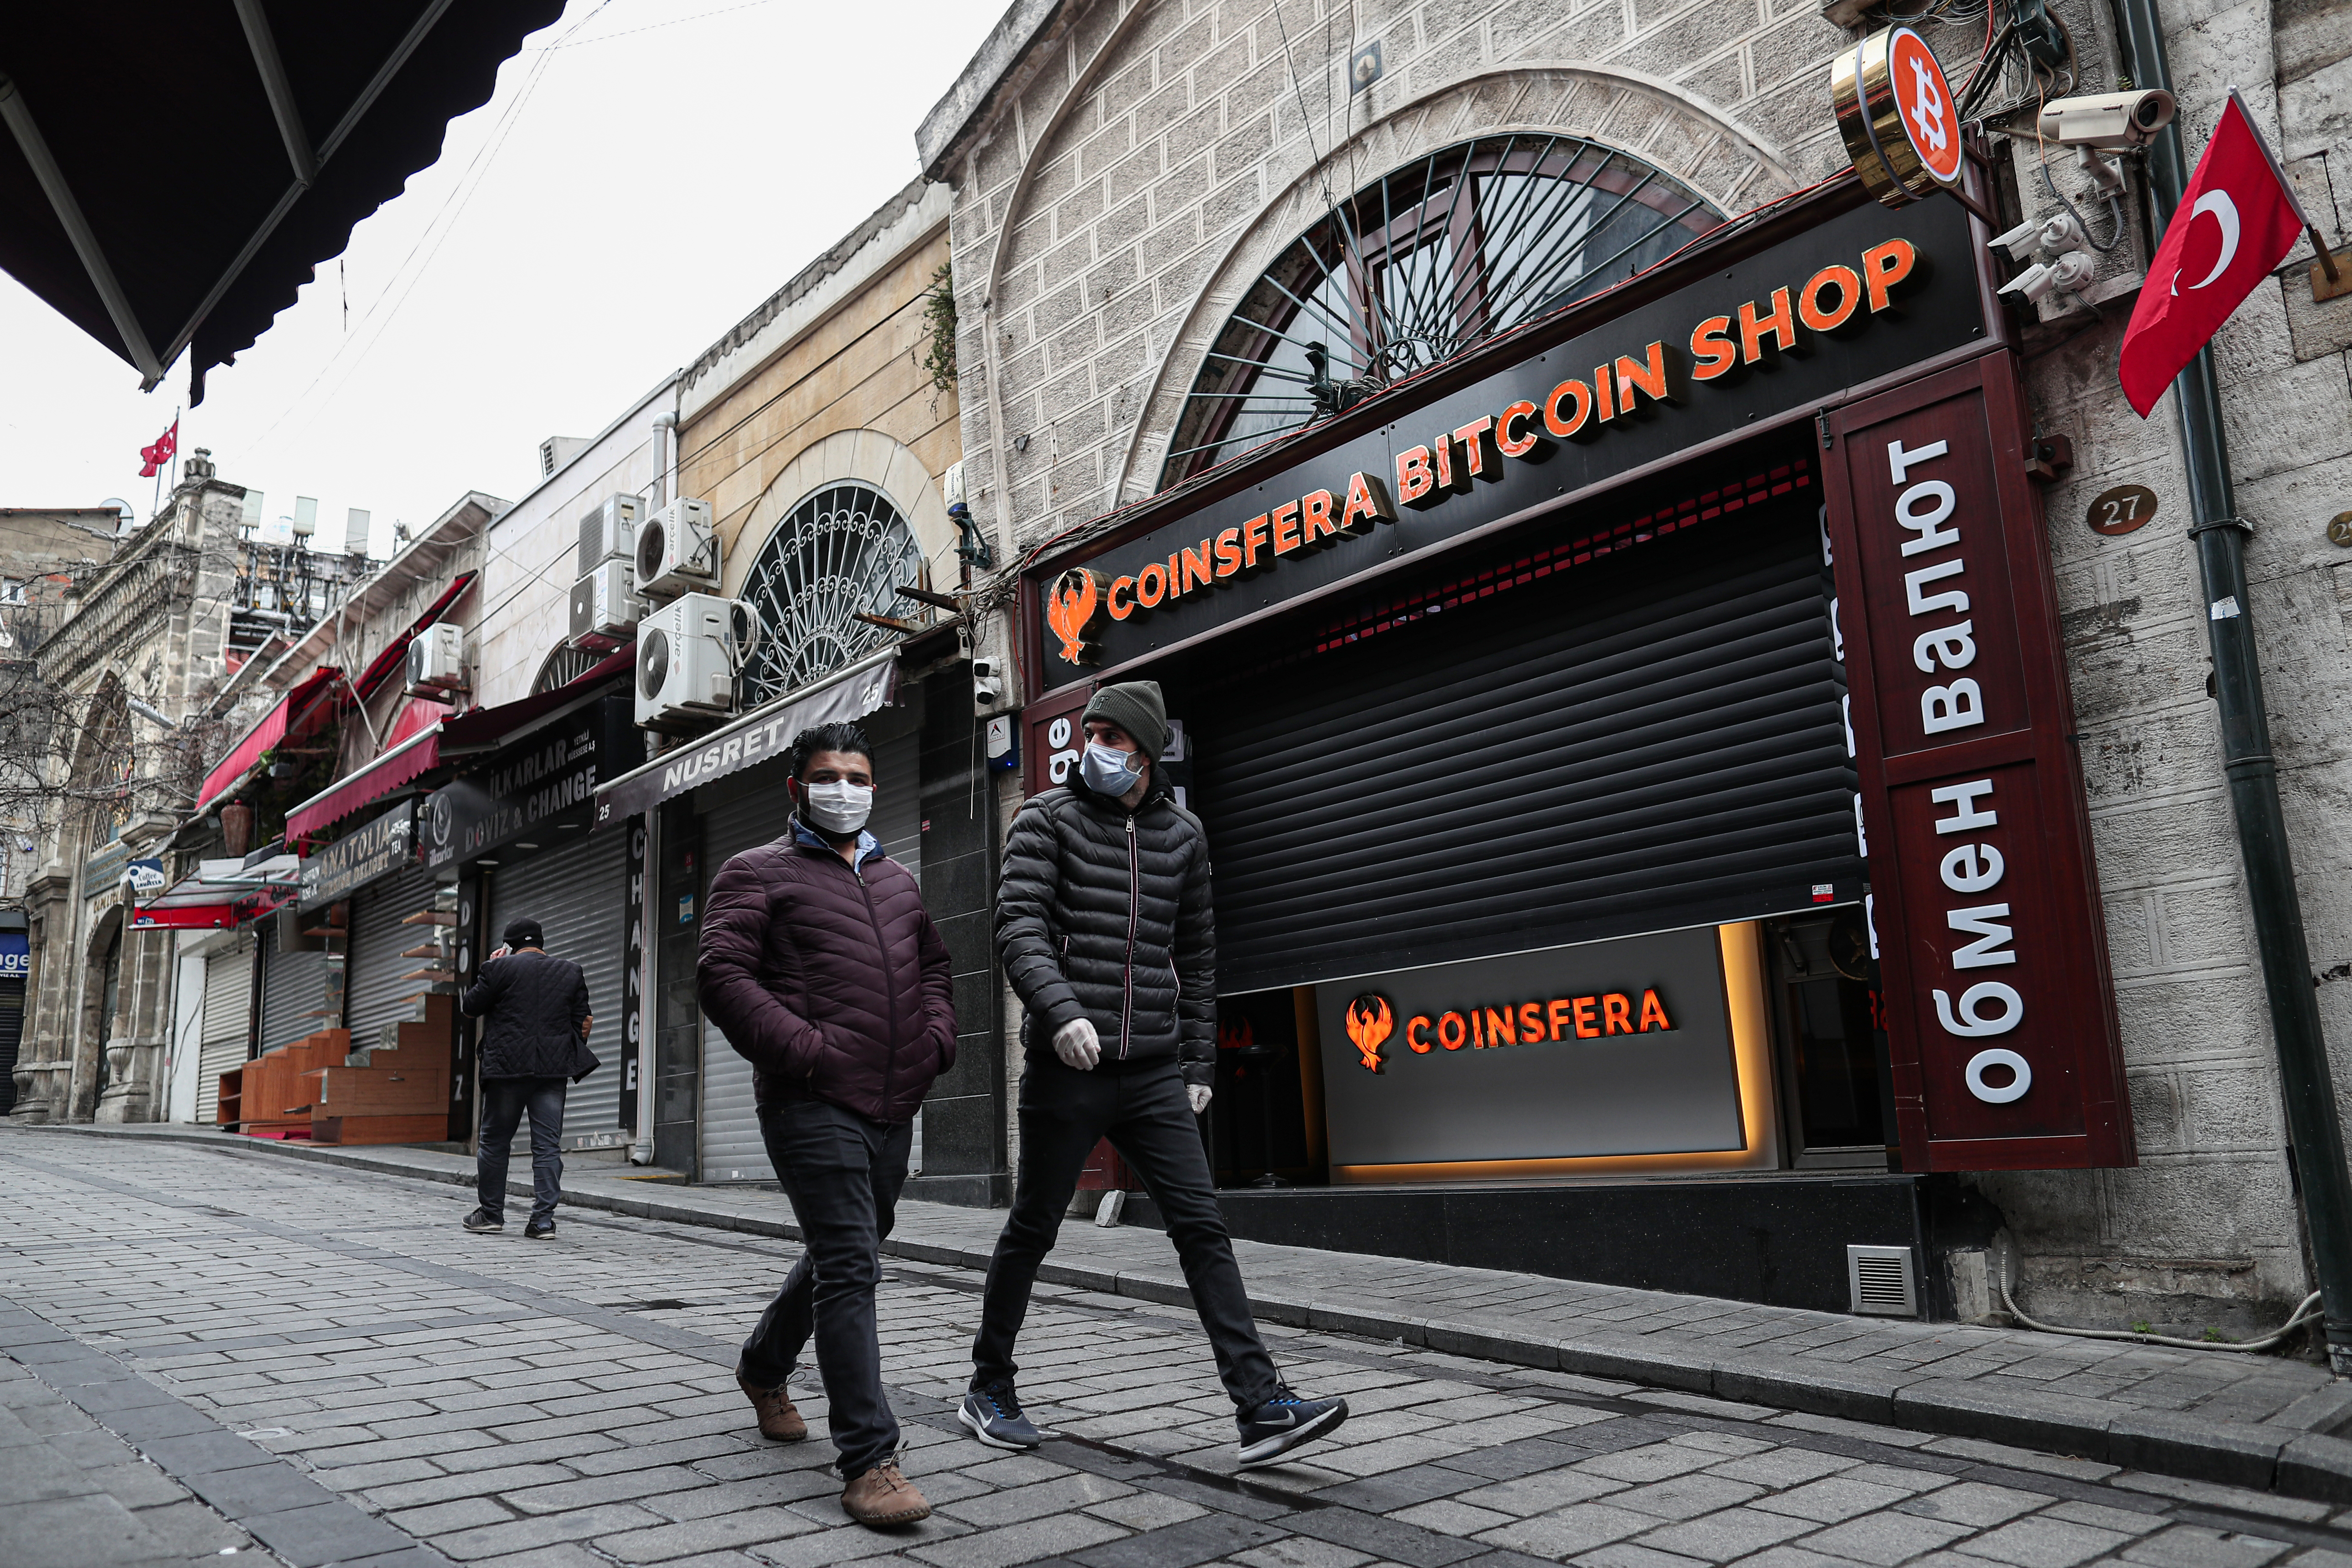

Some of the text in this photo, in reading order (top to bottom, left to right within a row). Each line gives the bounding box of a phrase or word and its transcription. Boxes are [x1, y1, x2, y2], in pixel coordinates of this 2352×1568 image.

[1106, 237, 1916, 620] COINSFERA BITCOIN SHOP
[2101, 493, 2140, 527] 27
[673, 604, 682, 657] arçelik
[863, 683, 879, 706] 25
[490, 739, 566, 802] İLKARLAR
[662, 716, 785, 792] NUSRET
[465, 765, 596, 853] DÖVİZ & CHANGE
[599, 804, 610, 821] 25
[319, 869, 352, 902] TURKISH
[352, 850, 389, 885] DELIGHT
[320, 818, 389, 881] ANATOLIA
[391, 838, 402, 856] TEA
[625, 828, 644, 1091] CHANGE
[1931, 777, 2032, 1104] обмен
[1406, 988, 1671, 1054] COINSFERA
